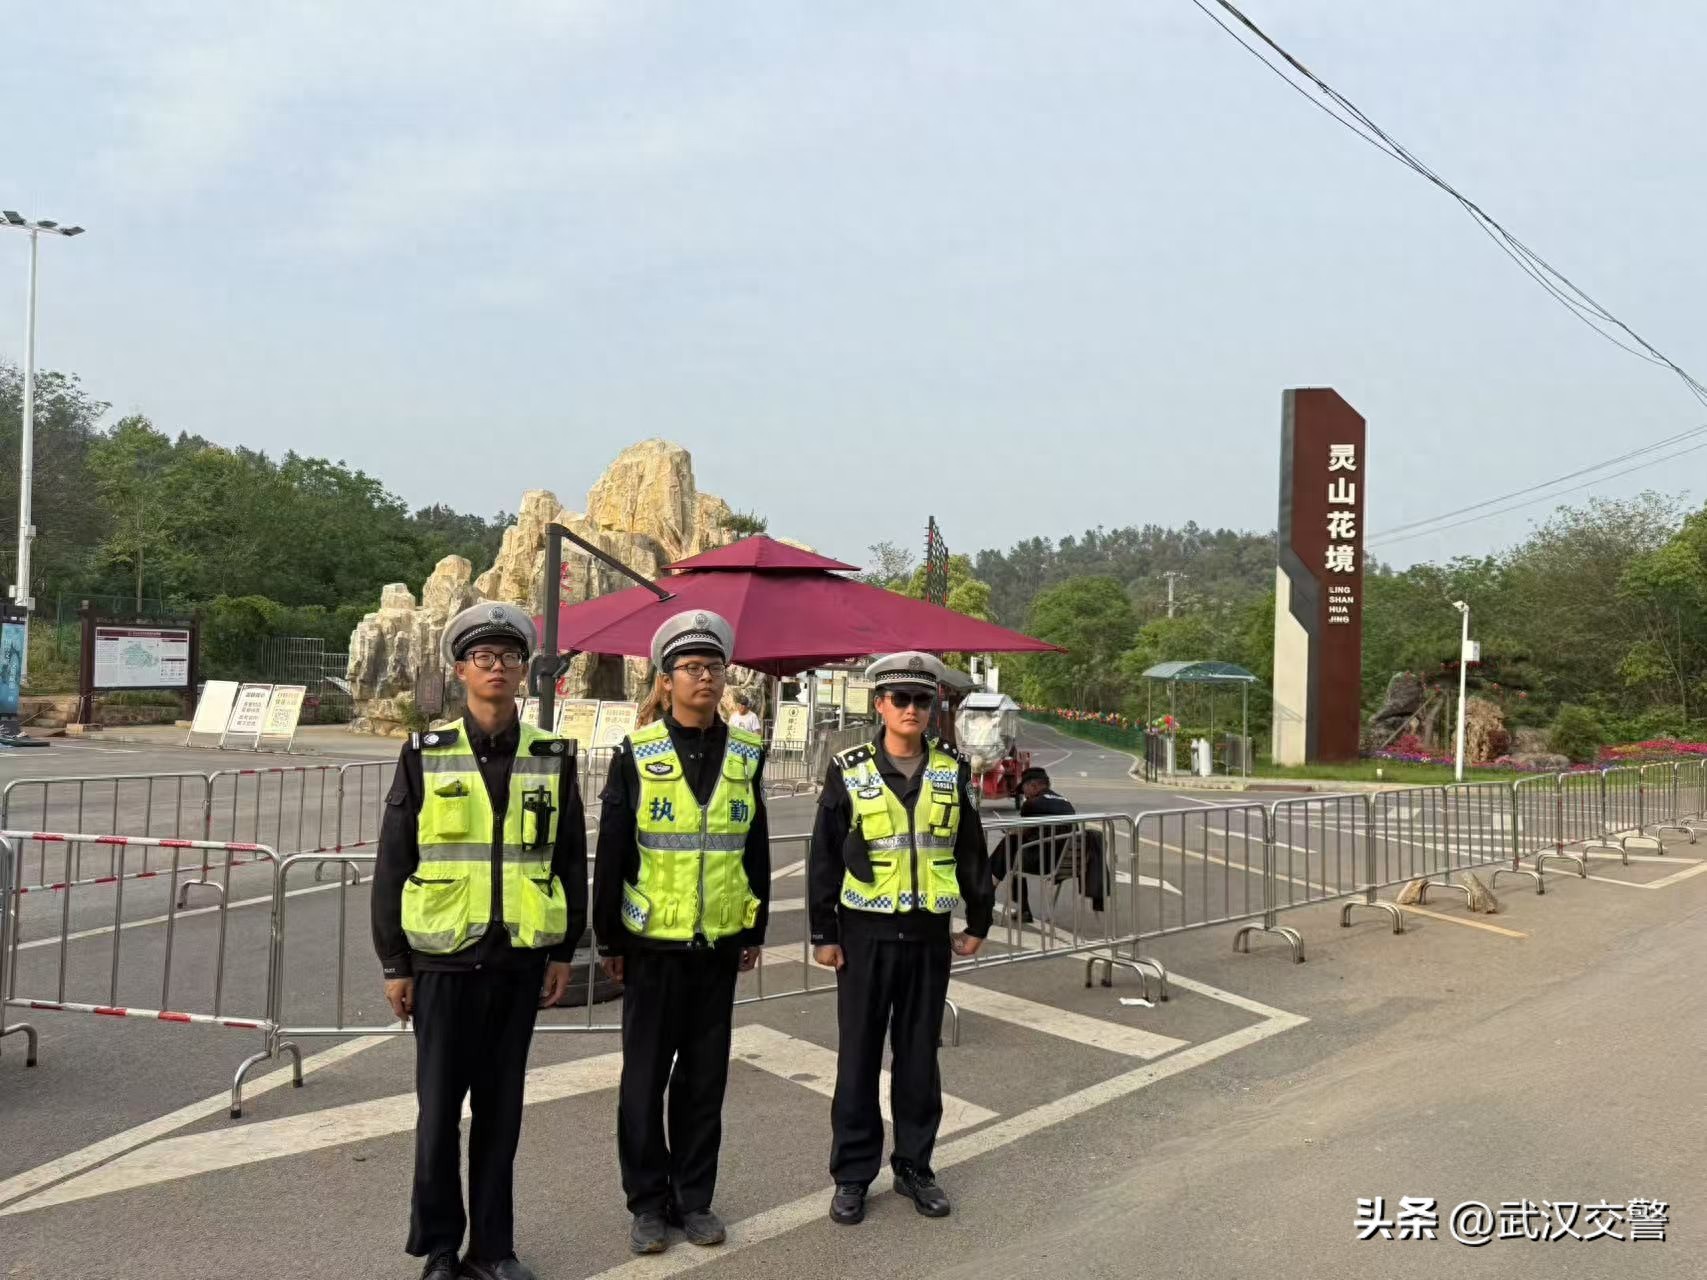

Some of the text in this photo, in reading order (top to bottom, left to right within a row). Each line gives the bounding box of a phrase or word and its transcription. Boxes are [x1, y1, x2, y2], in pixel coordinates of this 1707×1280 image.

[1325, 444, 1357, 573] 灵山花境
[1329, 586, 1351, 594] LING
[1329, 596, 1354, 604] SHAN
[1329, 606, 1348, 614] HUA
[1329, 616, 1350, 624] JING
[650, 797, 748, 822] 执 勤
